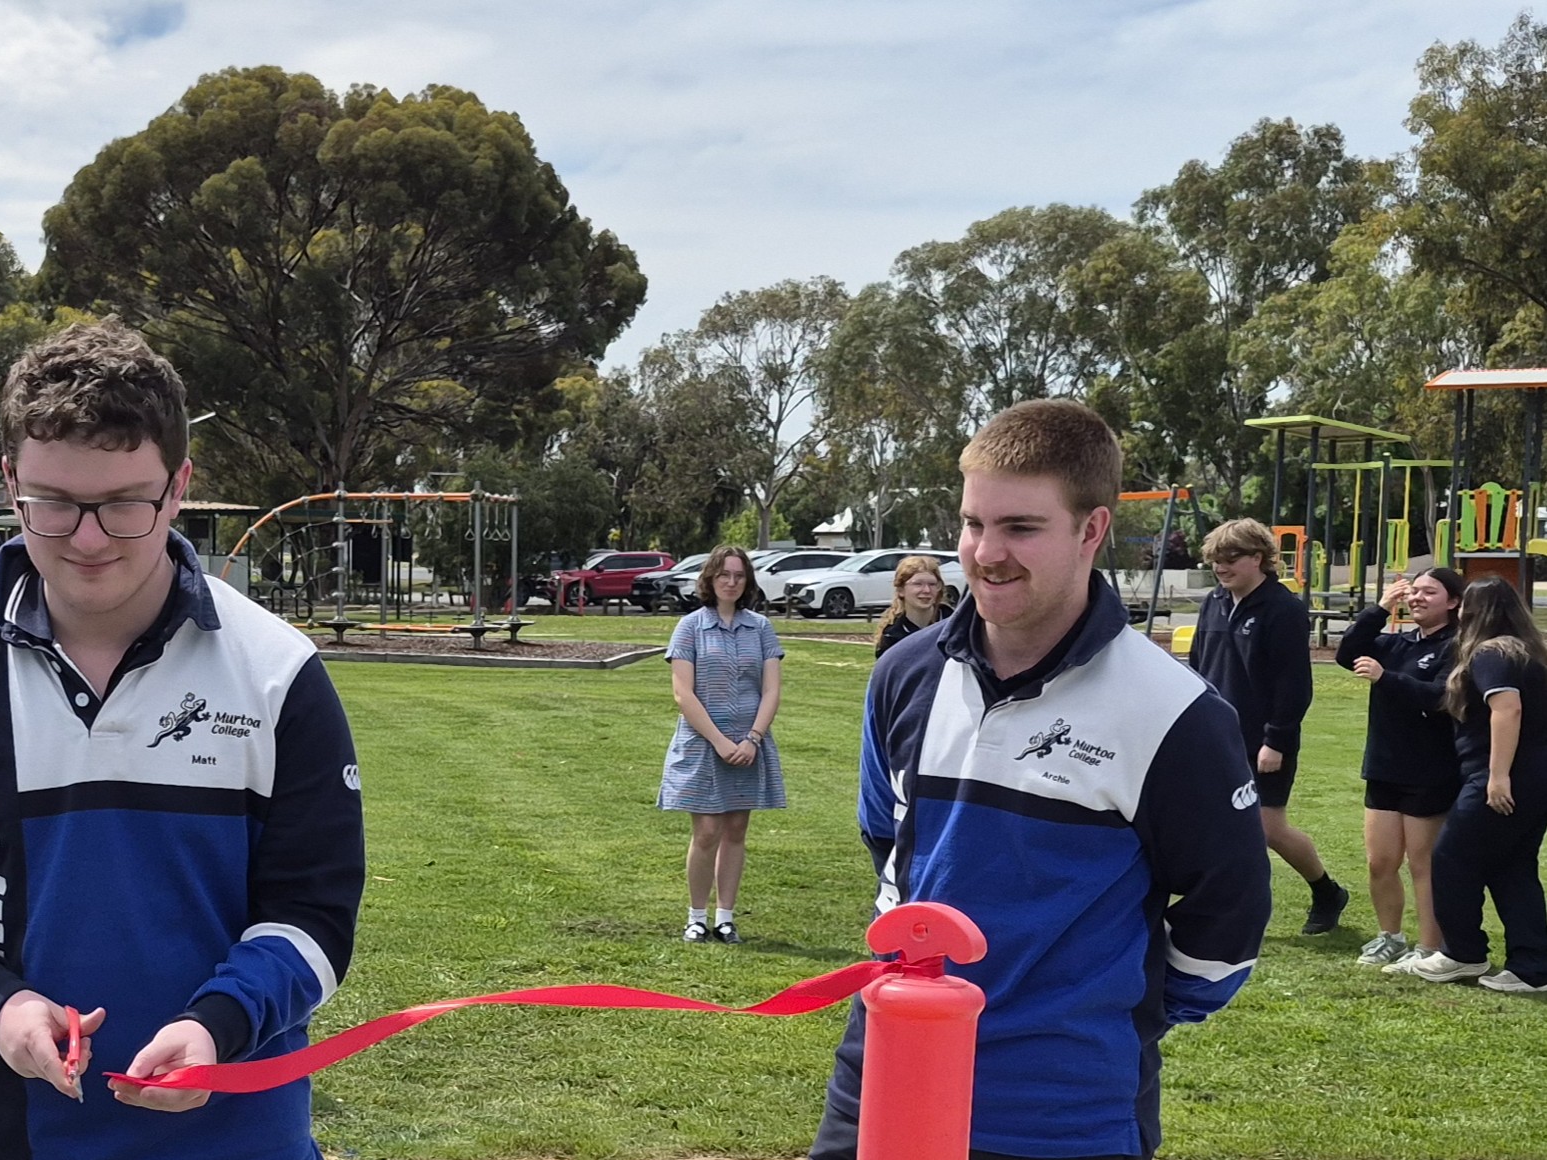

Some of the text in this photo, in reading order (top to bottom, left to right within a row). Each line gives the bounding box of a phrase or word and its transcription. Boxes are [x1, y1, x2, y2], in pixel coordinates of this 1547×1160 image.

[214, 711, 261, 729] Murtoa
[211, 724, 251, 738] College
[1073, 739, 1116, 760] Murtoa
[191, 755, 217, 765] Matt
[1068, 750, 1101, 766] College
[1042, 771, 1070, 785] Archie
